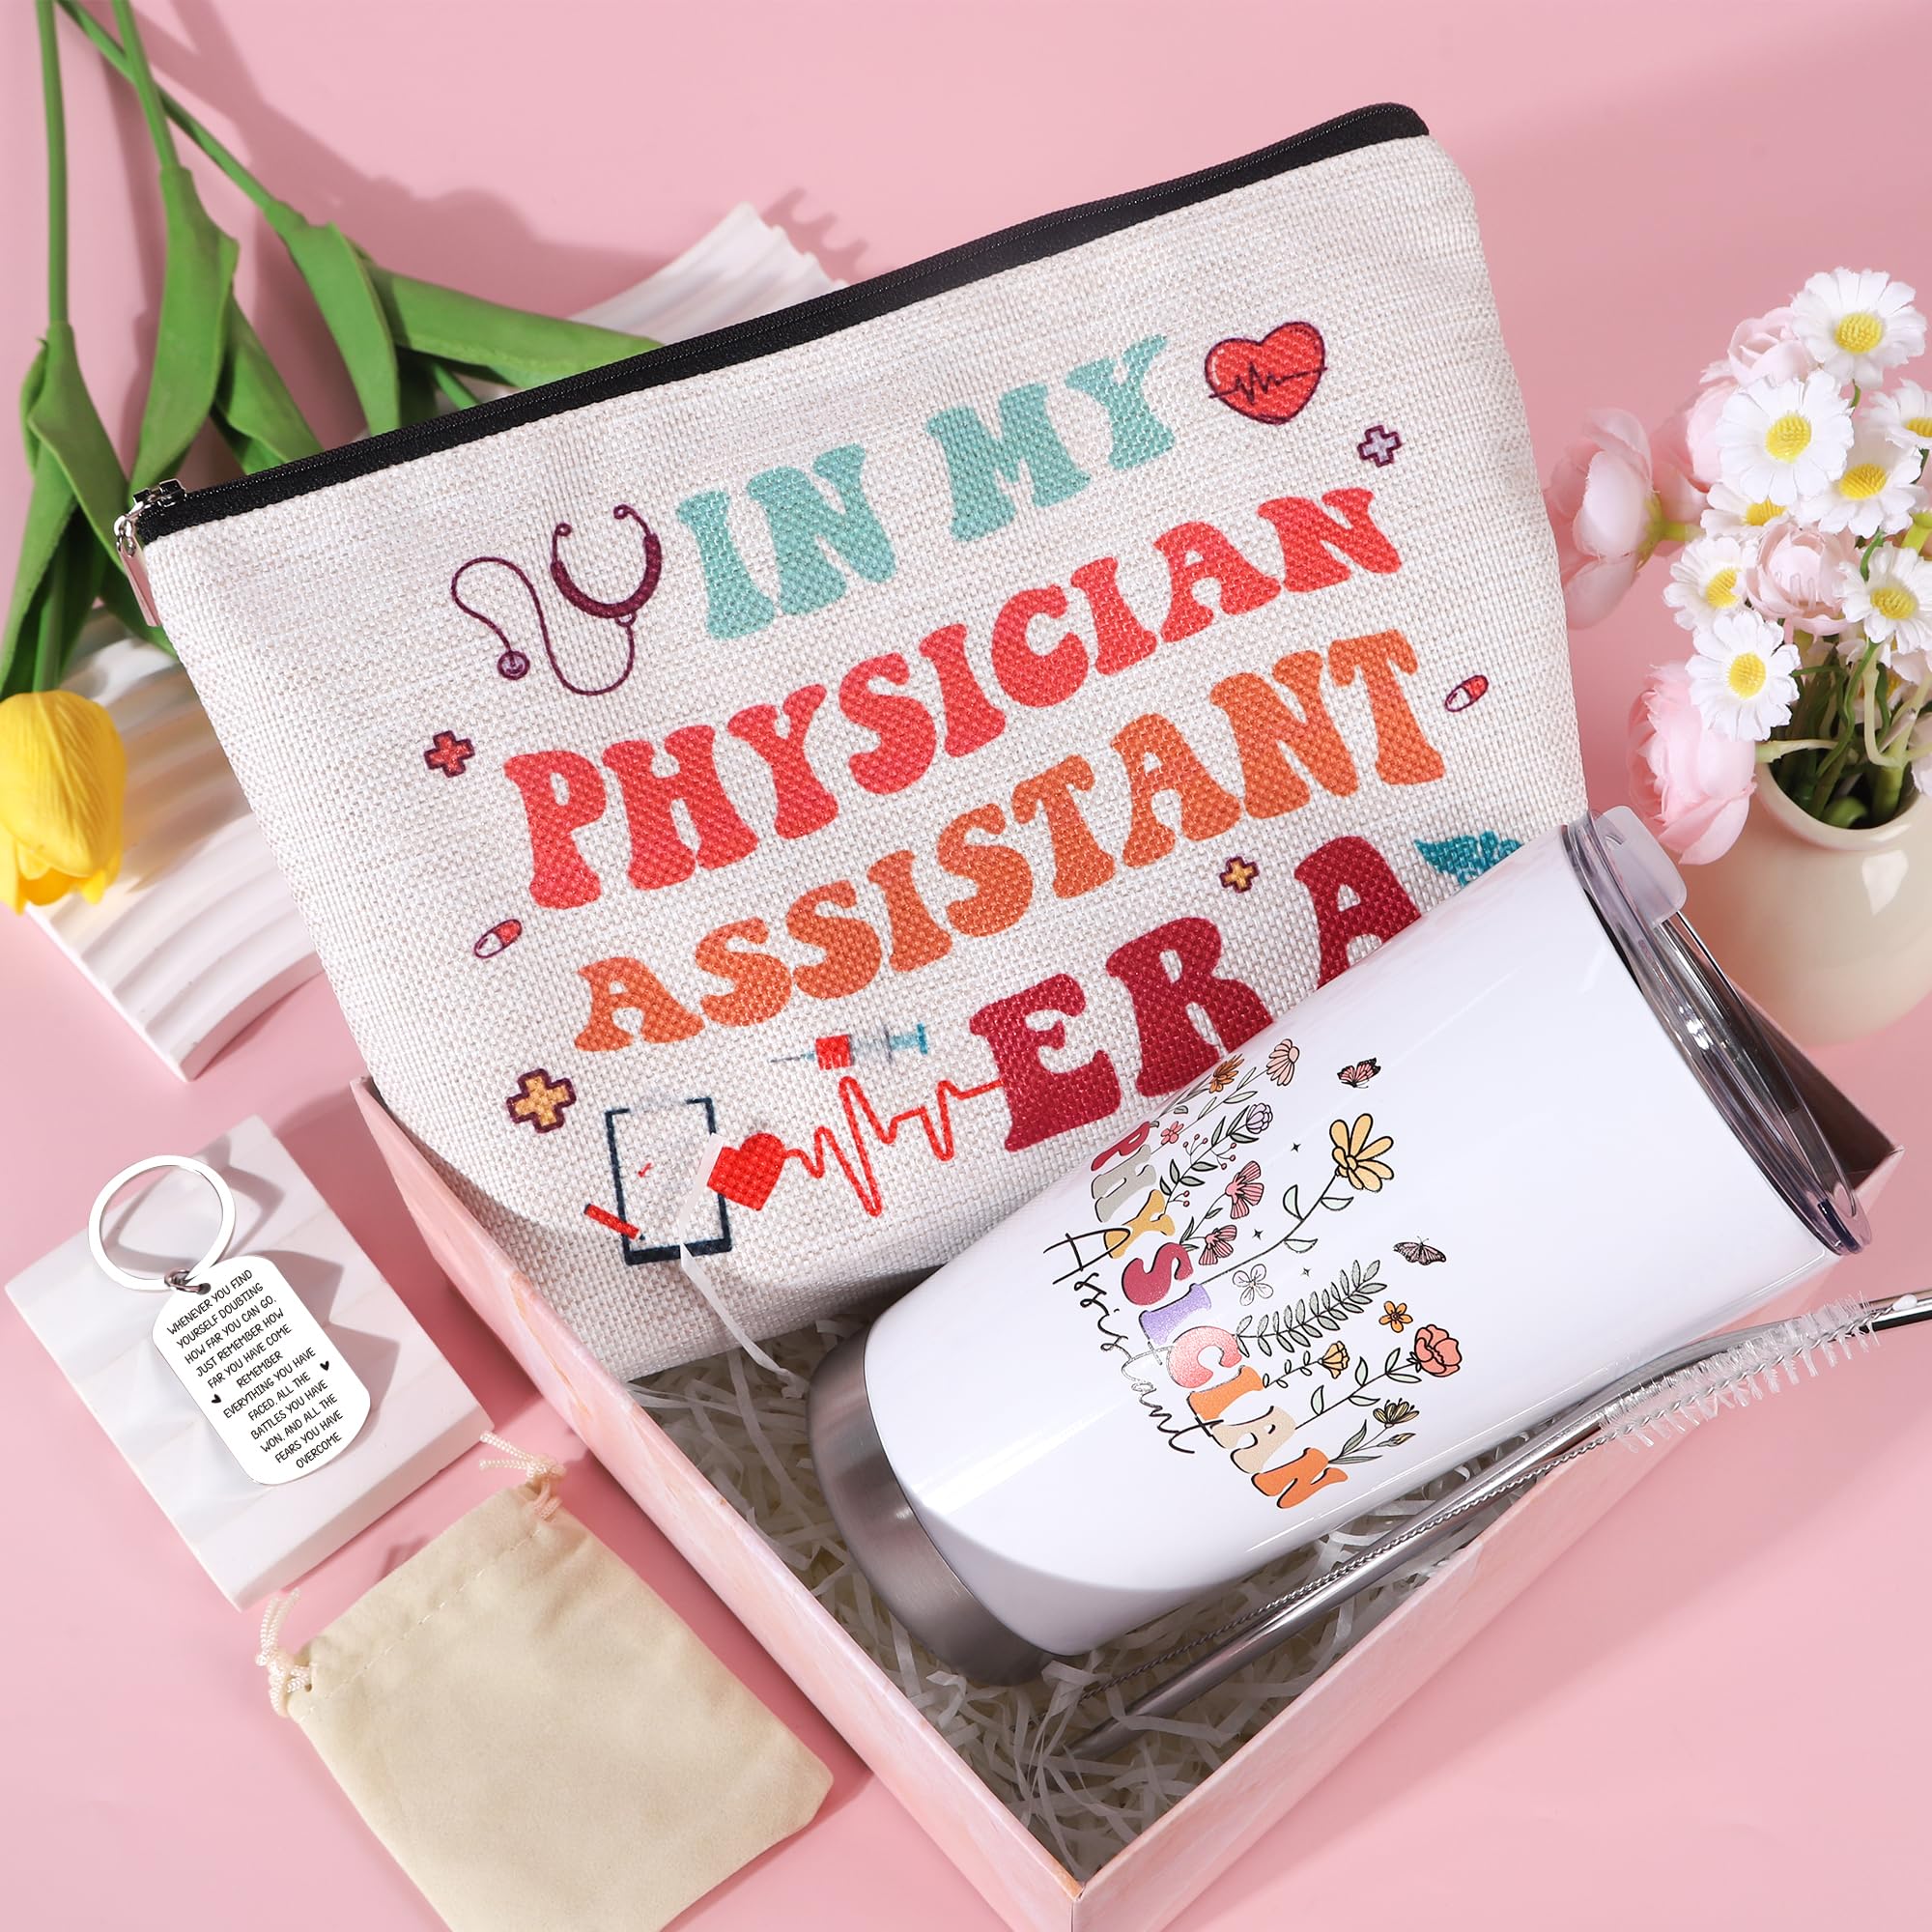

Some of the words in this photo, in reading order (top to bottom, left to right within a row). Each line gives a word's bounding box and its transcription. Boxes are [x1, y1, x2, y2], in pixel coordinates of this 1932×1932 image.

[679, 442, 897, 639] IN
[926, 335, 1178, 542] MY
[504, 488, 1402, 909] PHYSICIAN
[574, 629, 1444, 1051] ASSISTANT
[970, 836, 1421, 1151] ERA
[166, 1298, 213, 1335] WHENEVER
[211, 1285, 231, 1303] YOU
[230, 1269, 253, 1290] FIND
[176, 1314, 218, 1349] YOURSELF
[217, 1282, 264, 1320] DOUBTING
[184, 1344, 207, 1365] HOW
[205, 1332, 224, 1350] FAR
[221, 1319, 242, 1337] YOU
[241, 1304, 261, 1322] CAN
[195, 1355, 217, 1378] JUST
[216, 1323, 265, 1362] REMEMBER
[262, 1307, 284, 1328] HOW
[207, 1372, 226, 1389] FAR
[223, 1358, 243, 1377] YOU
[242, 1342, 267, 1363] HAVE
[265, 1323, 292, 1347] COME
[236, 1350, 283, 1389] REMEMBER
[222, 1378, 274, 1419] EVERYTHING
[272, 1363, 294, 1381] YOU
[292, 1347, 316, 1369] HAVE
[250, 1409, 287, 1440] BATTLES
[284, 1396, 305, 1414] YOU
[303, 1379, 328, 1401] HAVE
[276, 1385, 295, 1402] ALL
[292, 1371, 311, 1388] THE
[284, 1418, 303, 1437] AND
[303, 1407, 322, 1423] ALL
[318, 1393, 338, 1409] THE
[274, 1439, 302, 1463] FEARS
[299, 1426, 321, 1444] YOU
[319, 1409, 344, 1431] HAVE
[296, 1432, 342, 1468] OVERCOME
